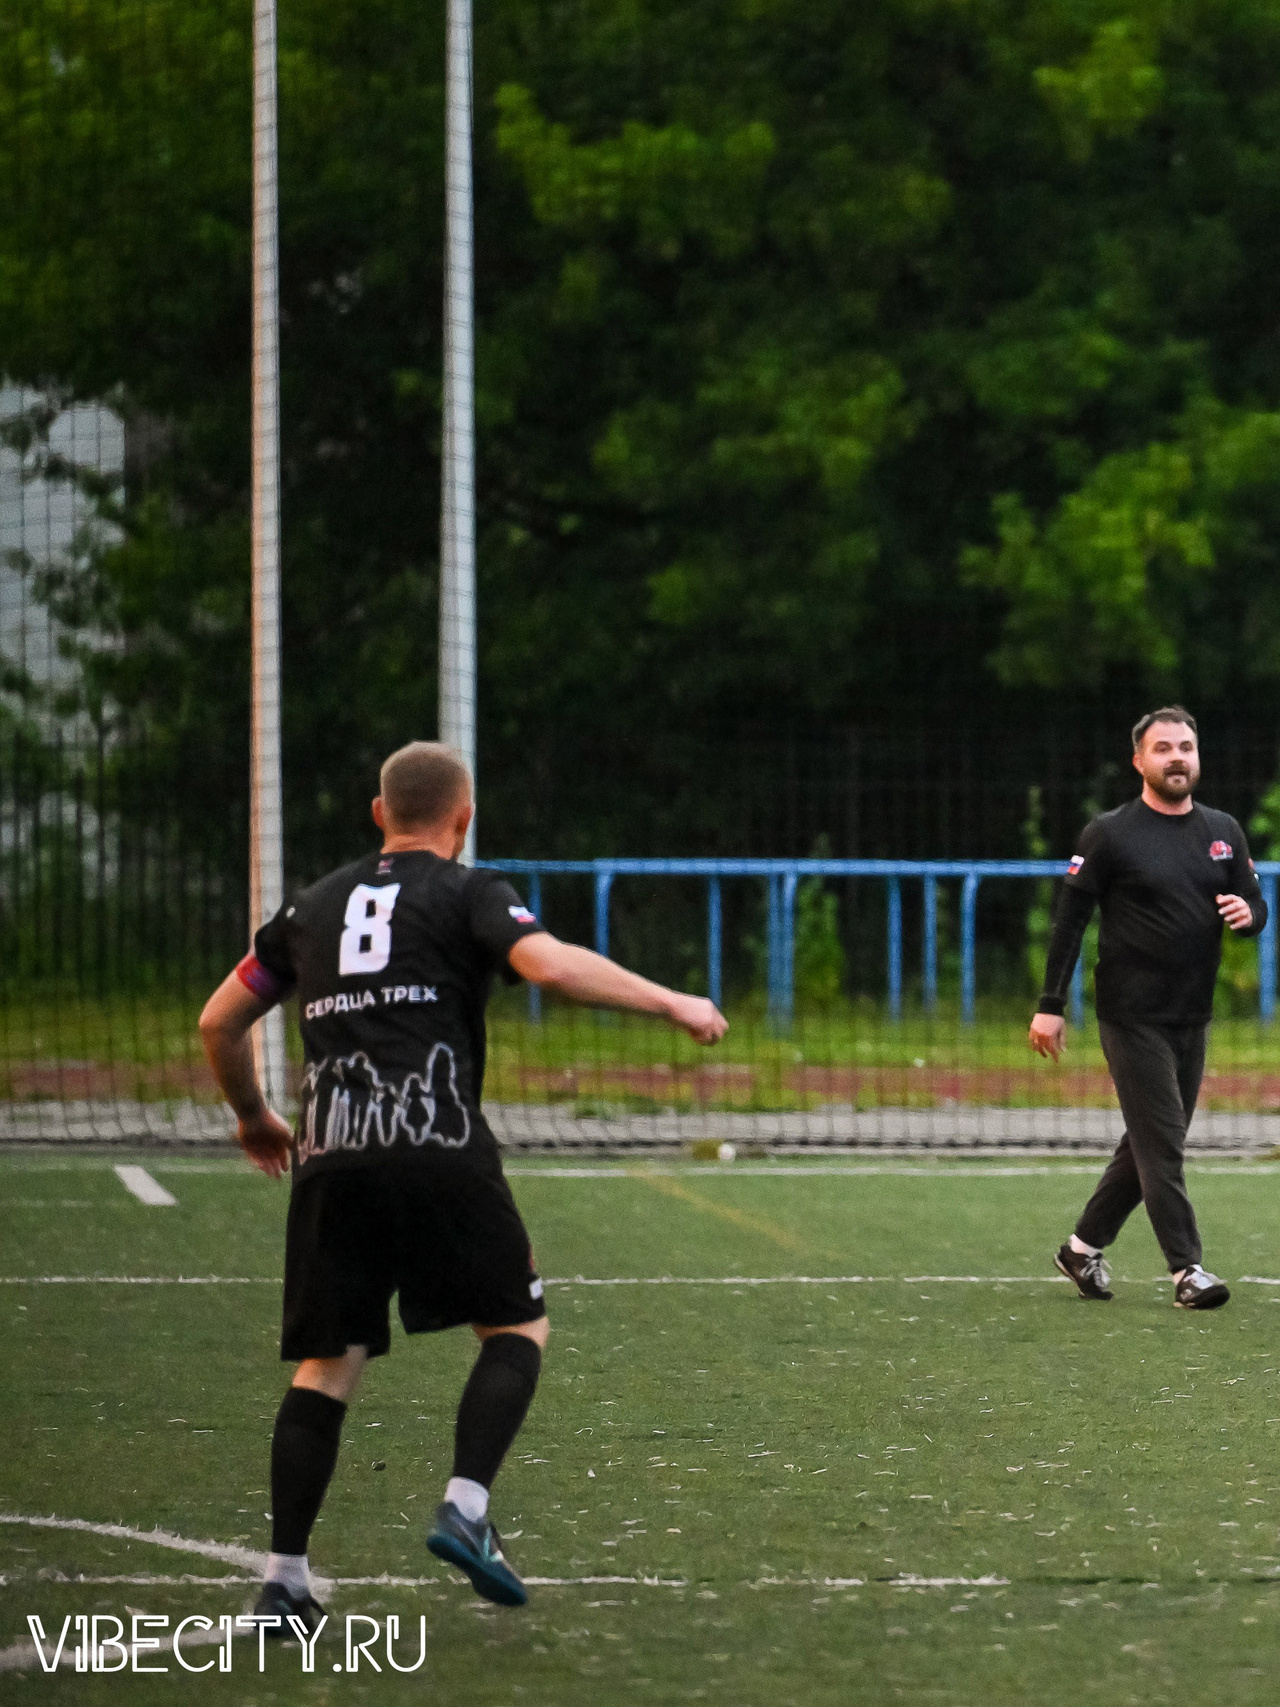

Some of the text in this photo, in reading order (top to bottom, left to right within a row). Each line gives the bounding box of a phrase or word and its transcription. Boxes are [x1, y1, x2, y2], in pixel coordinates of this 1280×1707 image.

[339, 882, 401, 976] 8
[305, 985, 438, 1020] СЕРДЦА ТРЕХ
